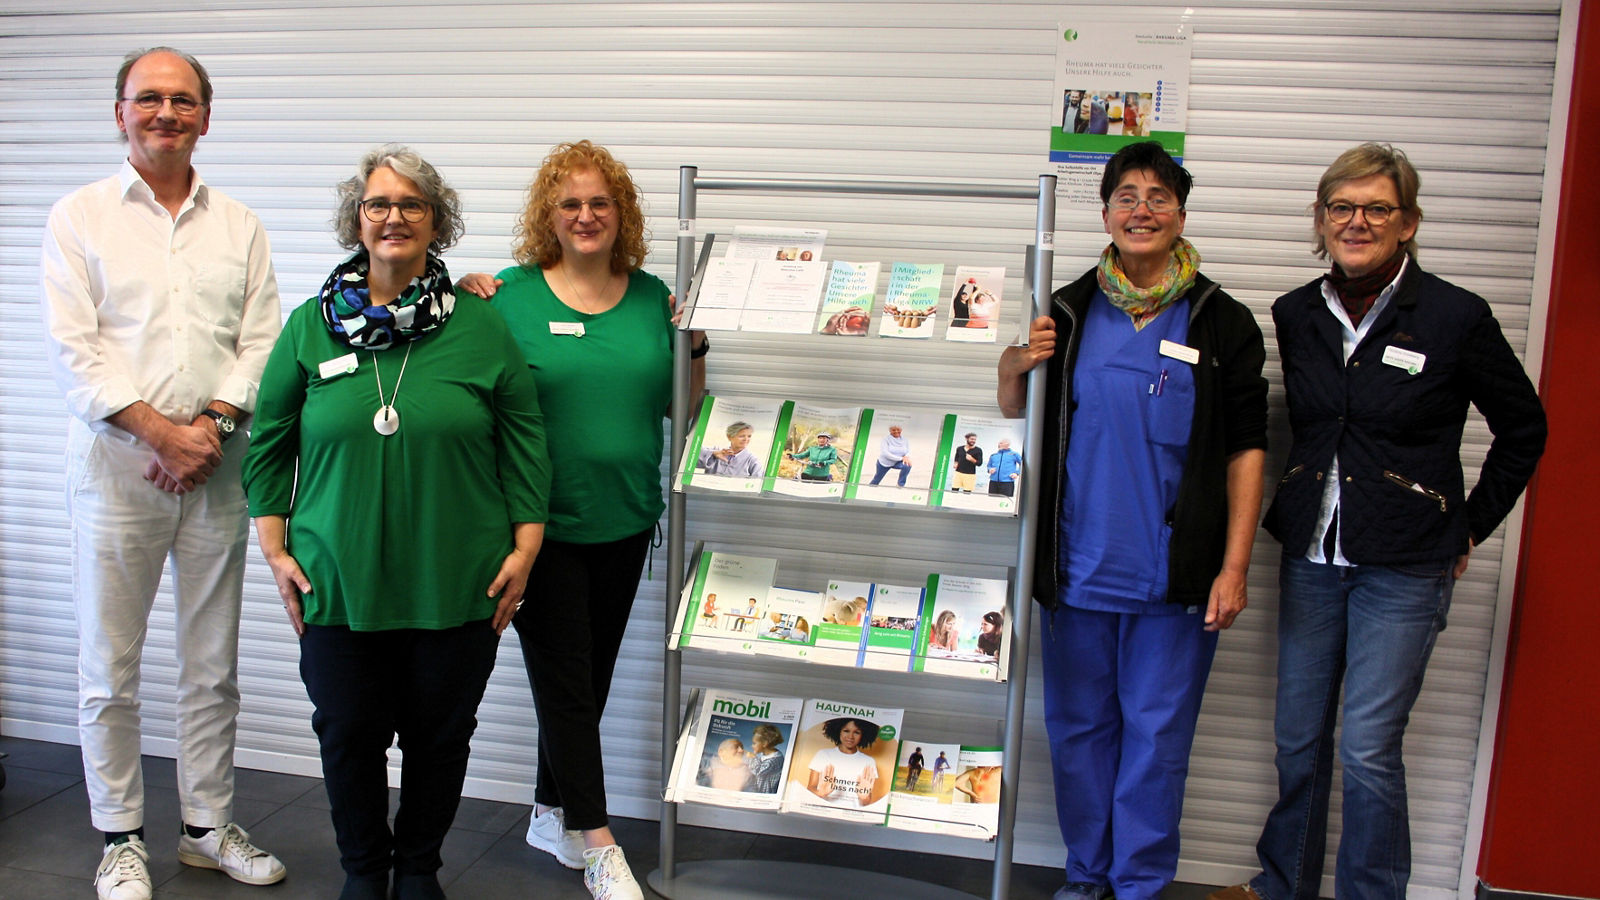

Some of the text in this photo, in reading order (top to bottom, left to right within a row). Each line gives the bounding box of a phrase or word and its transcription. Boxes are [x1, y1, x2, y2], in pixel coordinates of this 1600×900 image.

[713, 699, 771, 719] mobil
[816, 702, 875, 718] HAUTNAH
[824, 776, 860, 786] Schmerz
[830, 783, 847, 791] lass
